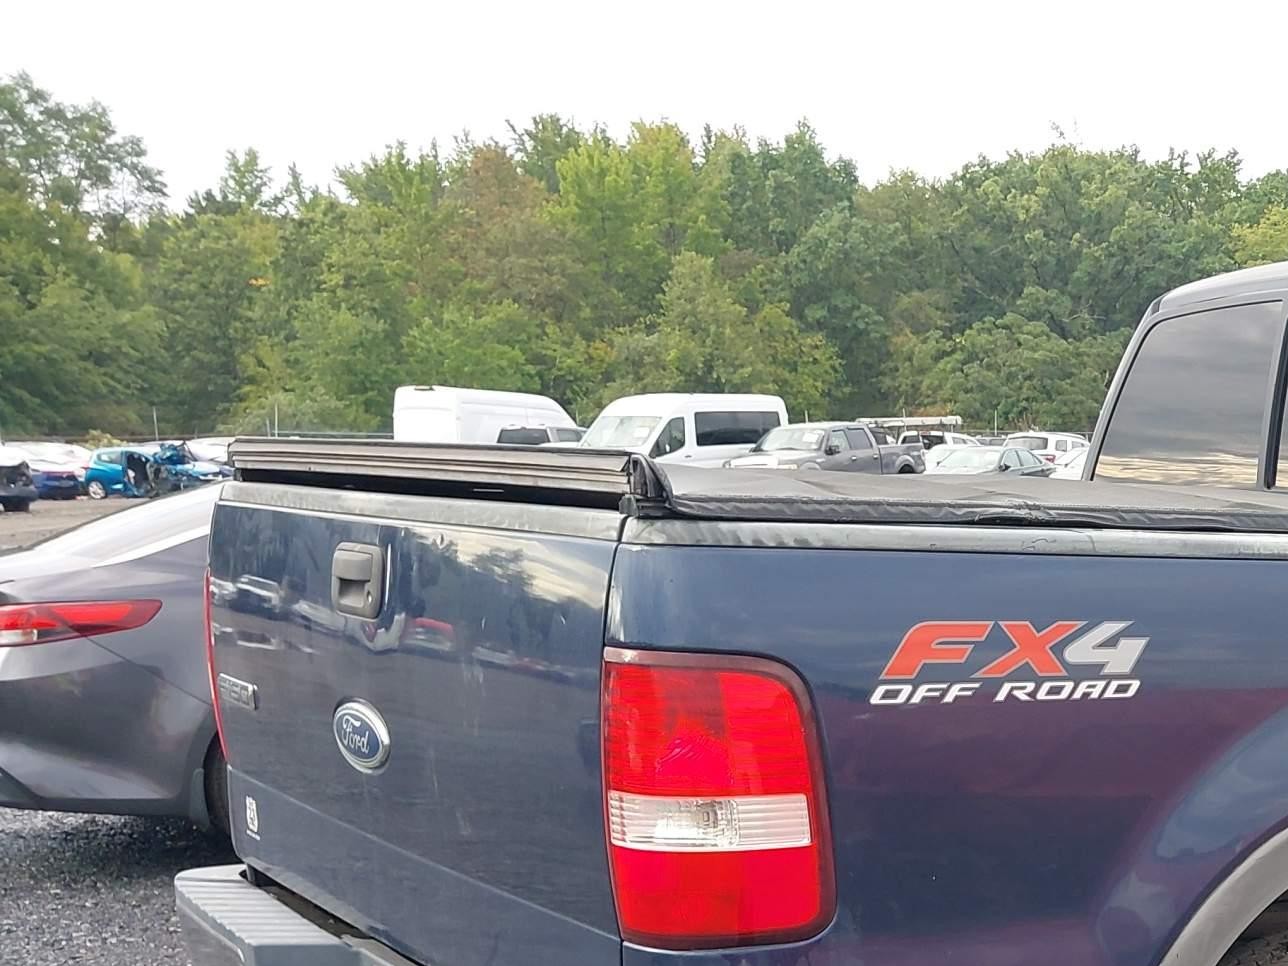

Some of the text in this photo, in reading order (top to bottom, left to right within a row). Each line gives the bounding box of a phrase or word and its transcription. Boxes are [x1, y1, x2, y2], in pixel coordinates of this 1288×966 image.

[879, 618, 1151, 679] FX4
[869, 679, 1141, 705] OFF ROAD
[341, 714, 370, 754] Ford
